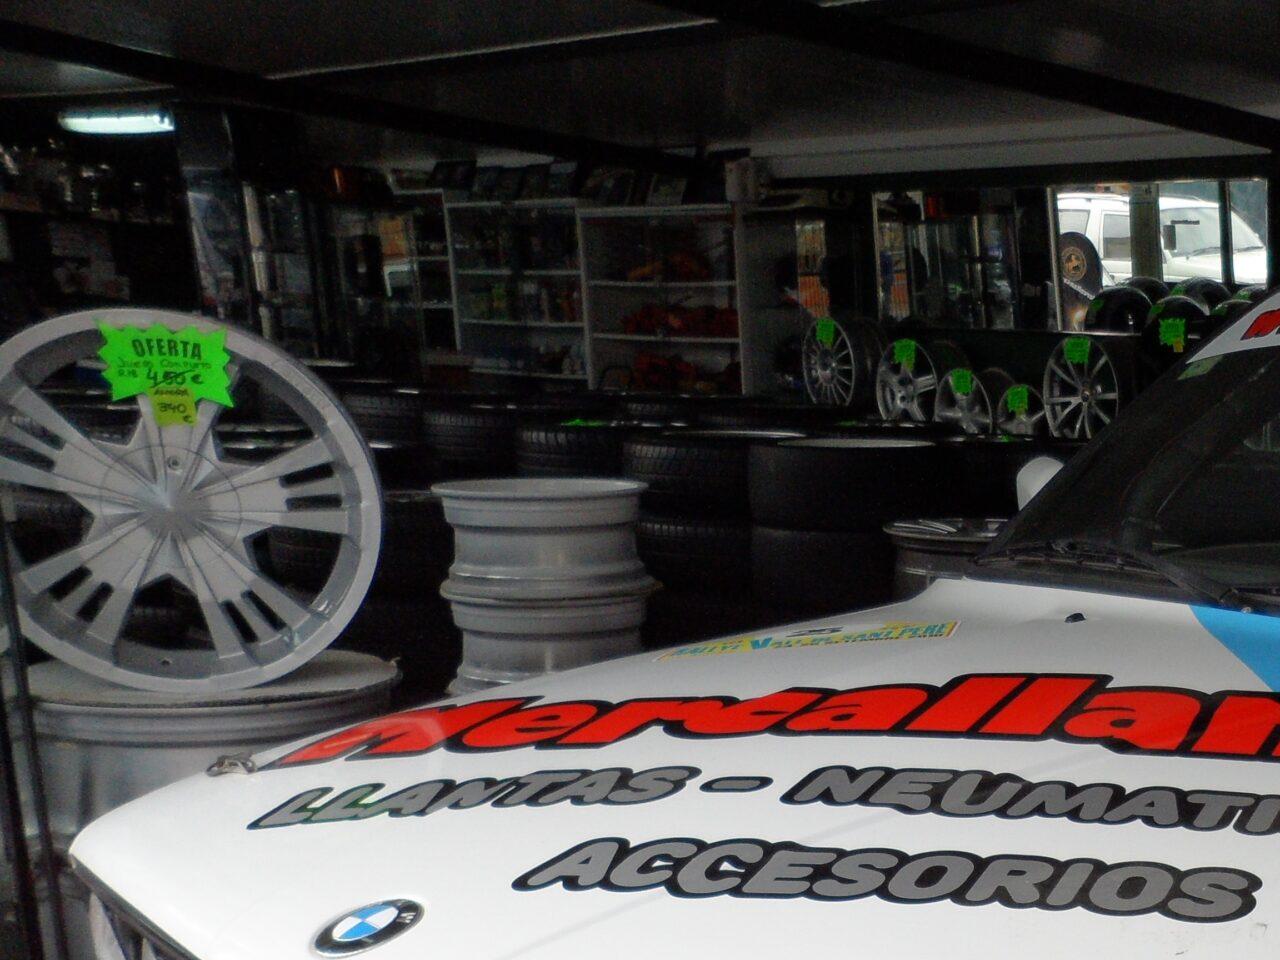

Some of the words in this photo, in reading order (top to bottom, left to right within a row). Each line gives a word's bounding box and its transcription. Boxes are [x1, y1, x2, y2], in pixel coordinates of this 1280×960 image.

[131, 338, 202, 361] OFERTA
[247, 766, 702, 830] LLANTAS
[513, 836, 1264, 924] ACCESORIOS
